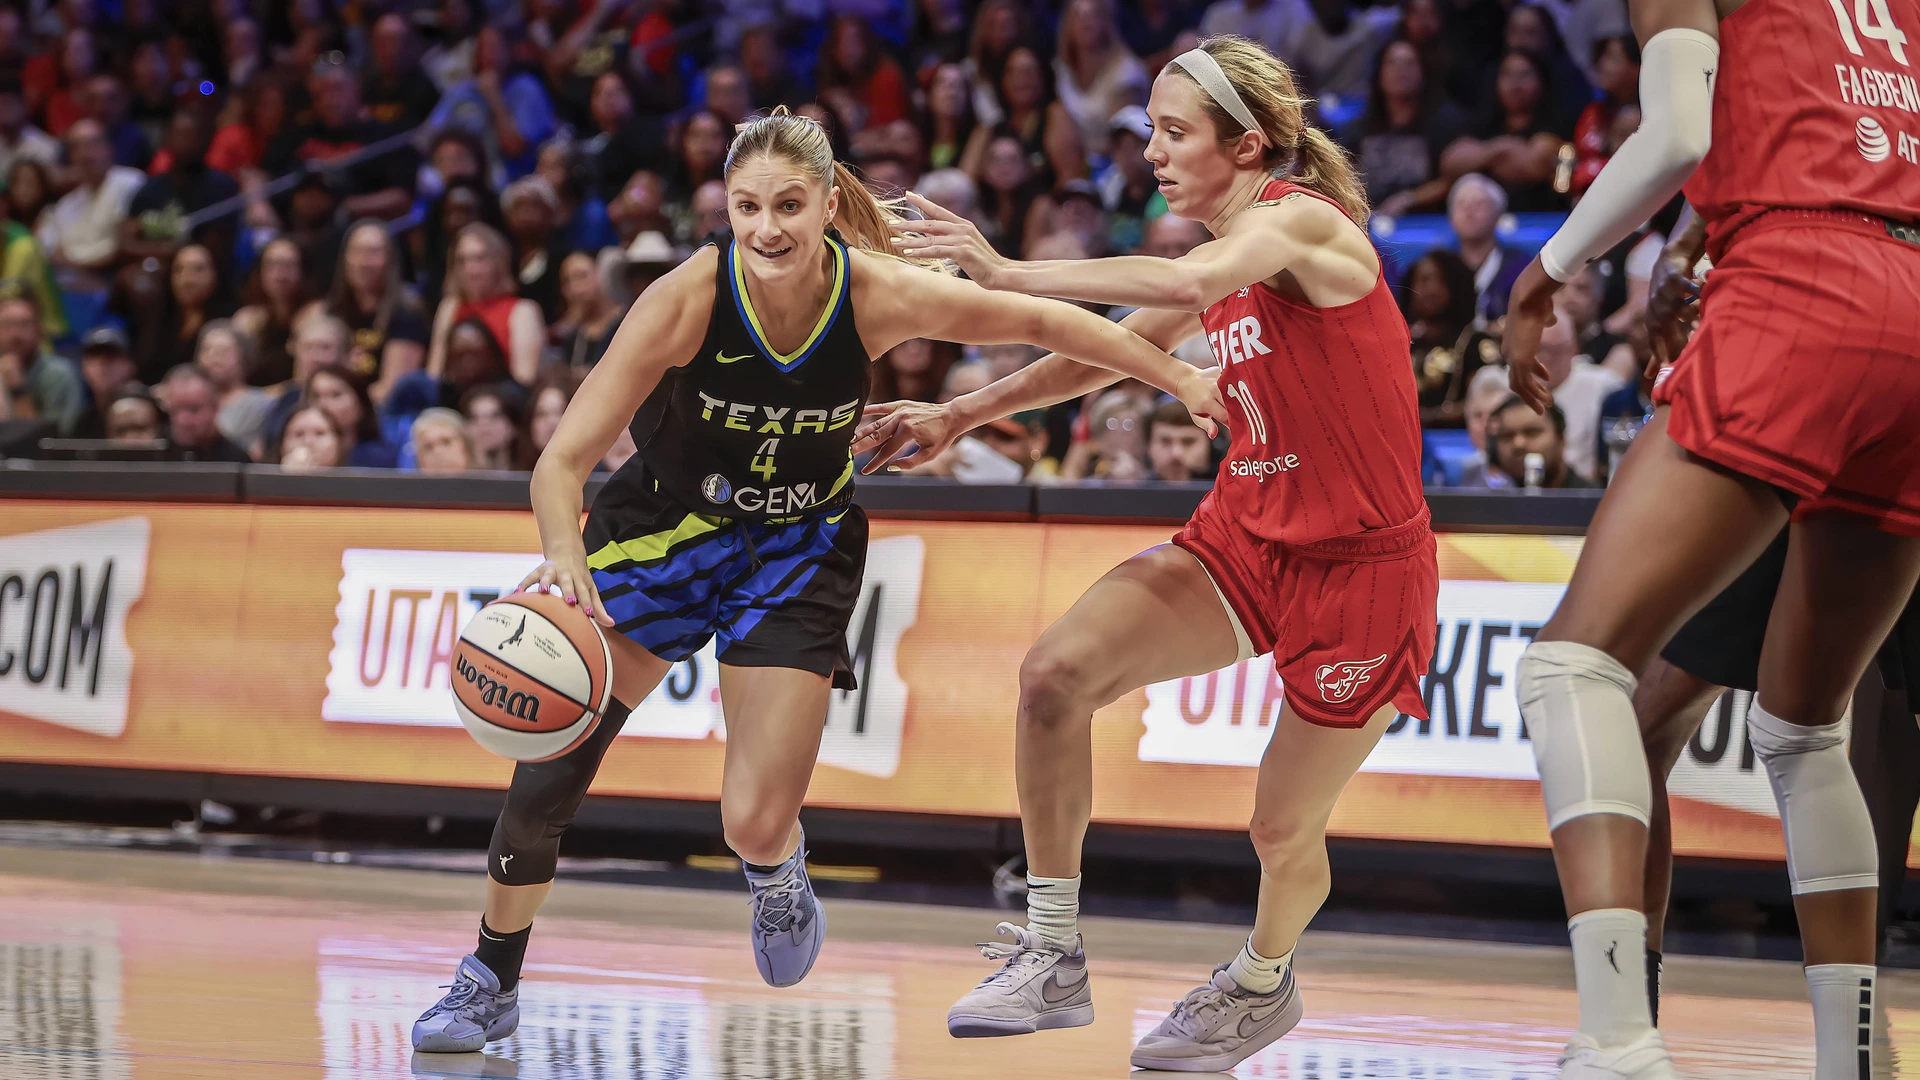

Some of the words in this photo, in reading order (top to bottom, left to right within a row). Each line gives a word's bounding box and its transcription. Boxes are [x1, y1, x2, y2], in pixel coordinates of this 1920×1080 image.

[1828, 0, 1910, 67] 14
[1834, 63, 1920, 113] FAGBEN
[1208, 315, 1273, 371] EVER
[698, 390, 860, 435] TEXAS
[1226, 380, 1267, 446] 10
[750, 438, 780, 483] 4
[733, 481, 817, 514] GEM
[455, 651, 541, 723] Wilson
